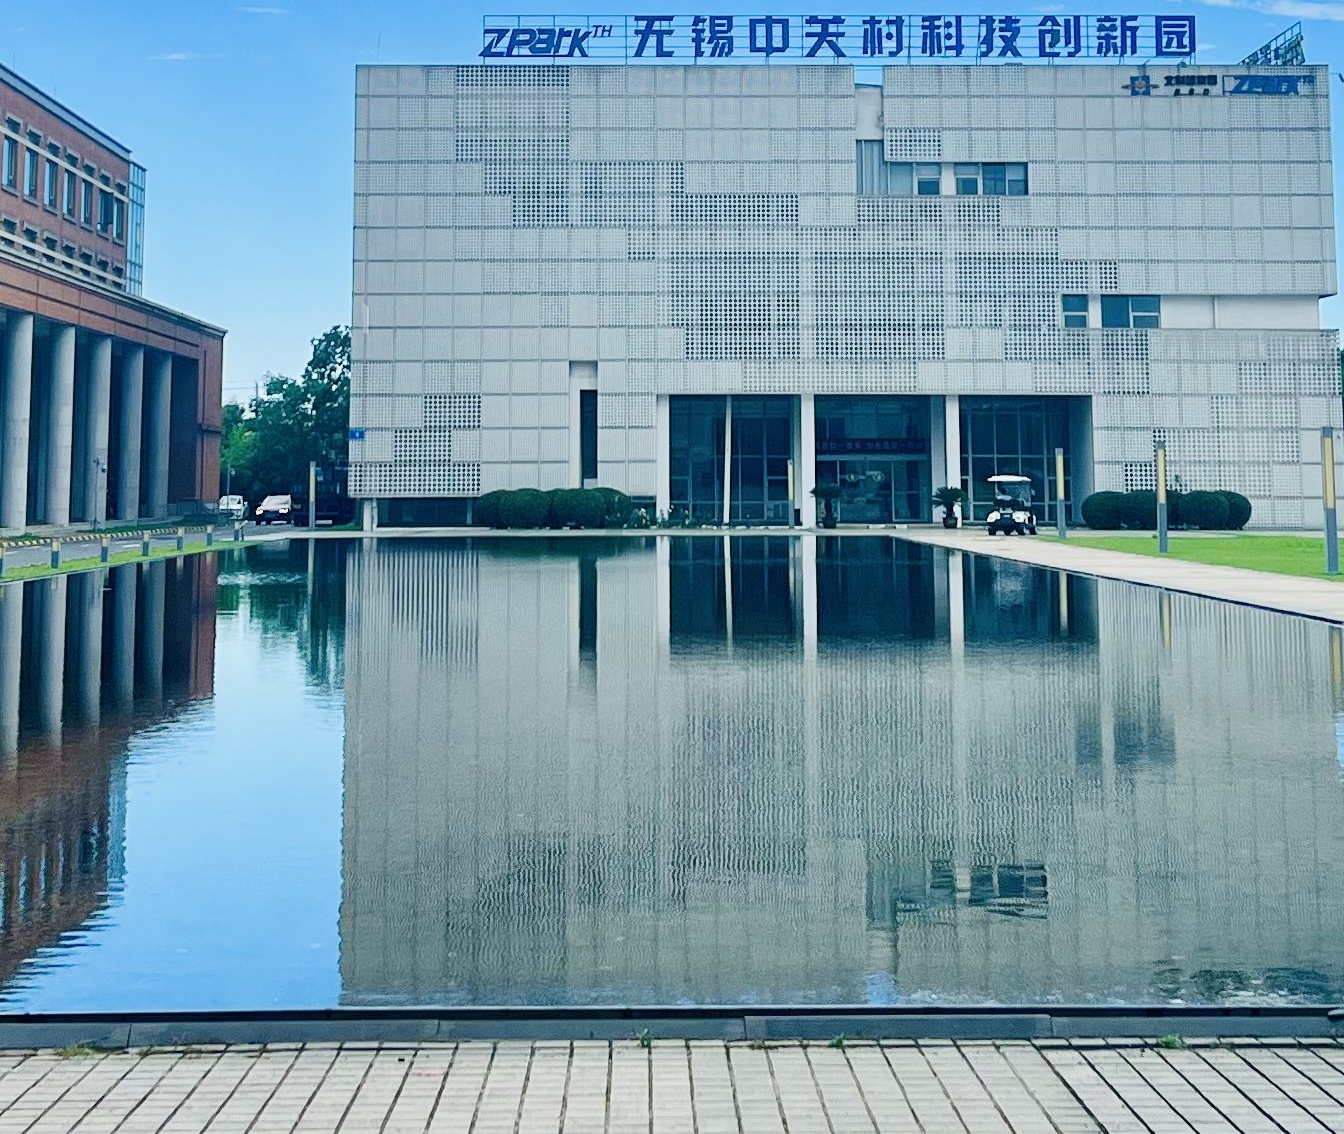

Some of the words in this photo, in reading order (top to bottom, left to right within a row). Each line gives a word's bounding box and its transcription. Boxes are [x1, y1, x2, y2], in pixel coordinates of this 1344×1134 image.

[634, 15, 1196, 57] 无锡中关村科技创新园
